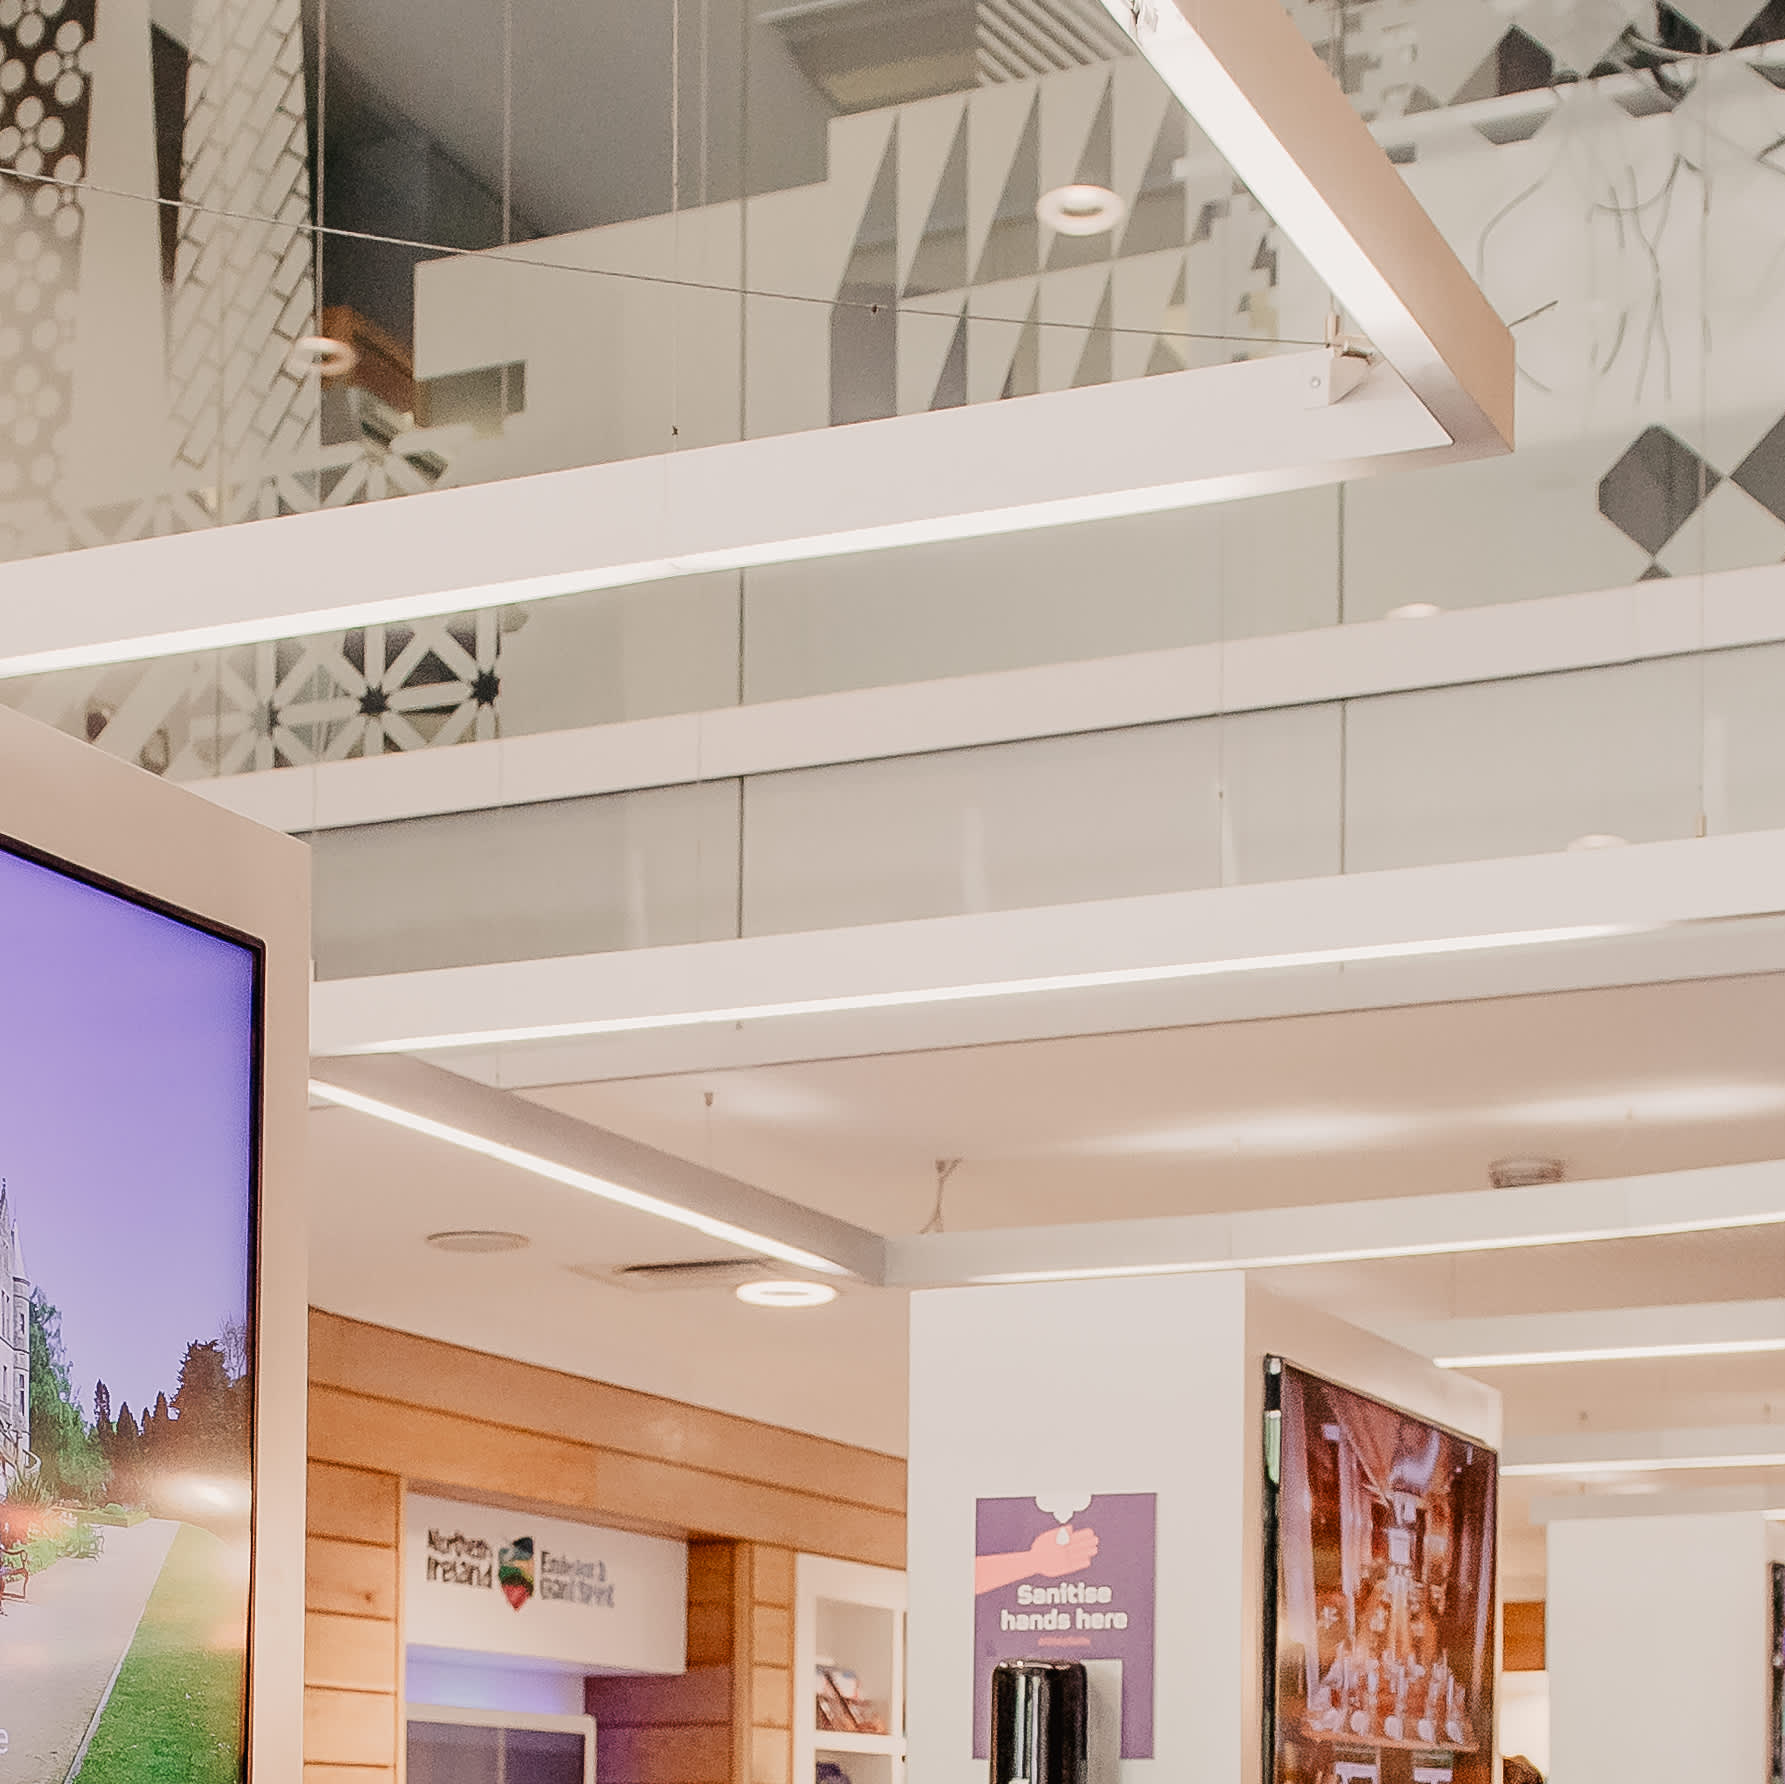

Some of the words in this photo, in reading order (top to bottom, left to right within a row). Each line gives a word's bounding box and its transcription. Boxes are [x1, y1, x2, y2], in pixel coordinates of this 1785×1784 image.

[1017, 1583, 1112, 1605] Sanitise
[1001, 1609, 1071, 1631] hands
[1076, 1608, 1128, 1630] here
